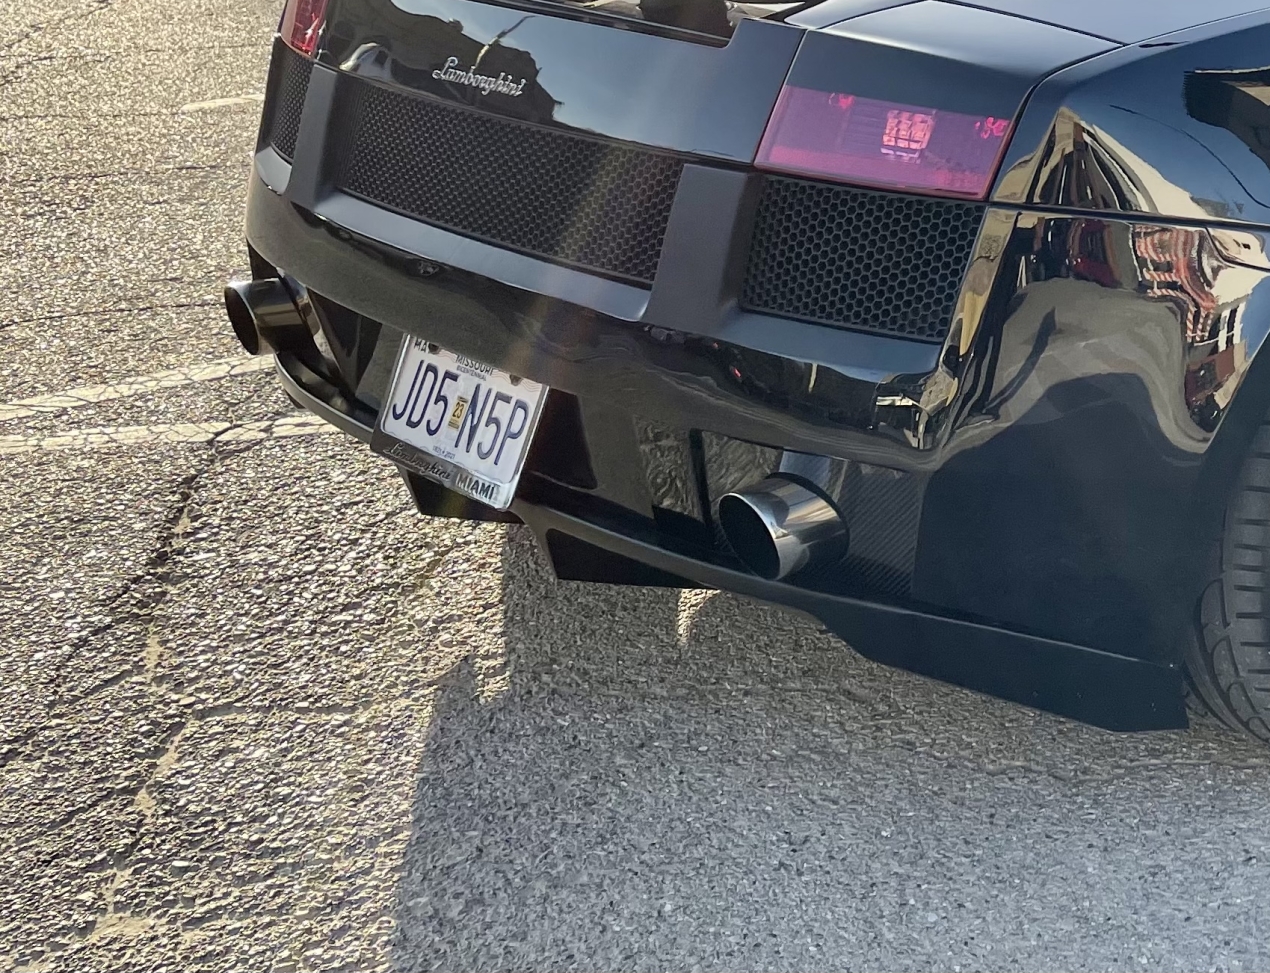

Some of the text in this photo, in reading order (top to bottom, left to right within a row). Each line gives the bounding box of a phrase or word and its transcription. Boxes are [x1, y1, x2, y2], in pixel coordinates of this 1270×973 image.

[432, 56, 527, 97] Lamborghini
[455, 353, 494, 377] MISSOURI
[392, 359, 529, 466] JD5 N5P
[452, 401, 465, 419] 23
[455, 472, 497, 501] MIAMI
